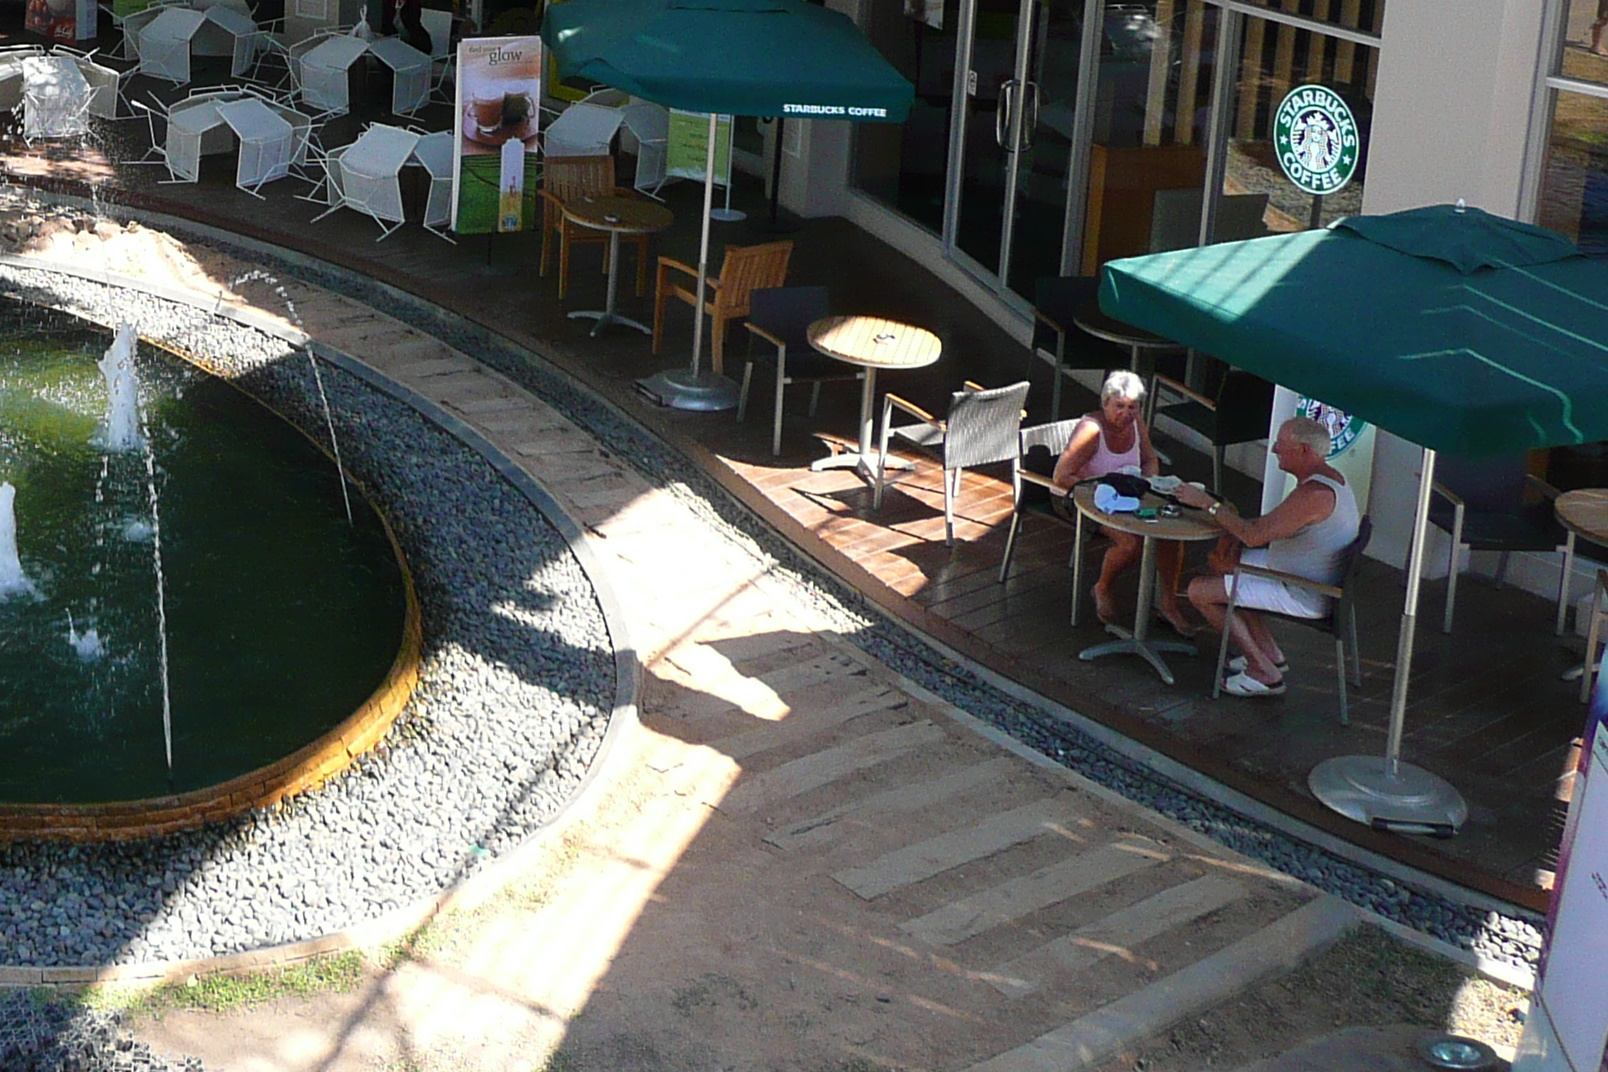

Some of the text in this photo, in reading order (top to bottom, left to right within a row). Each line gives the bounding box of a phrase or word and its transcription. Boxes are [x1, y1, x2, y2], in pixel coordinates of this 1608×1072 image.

[489, 47, 523, 66] glow
[783, 103, 887, 118] STARBUCKS COFFEE
[1280, 90, 1355, 147] STARBUCKS
[1283, 151, 1342, 189] COFFEE
